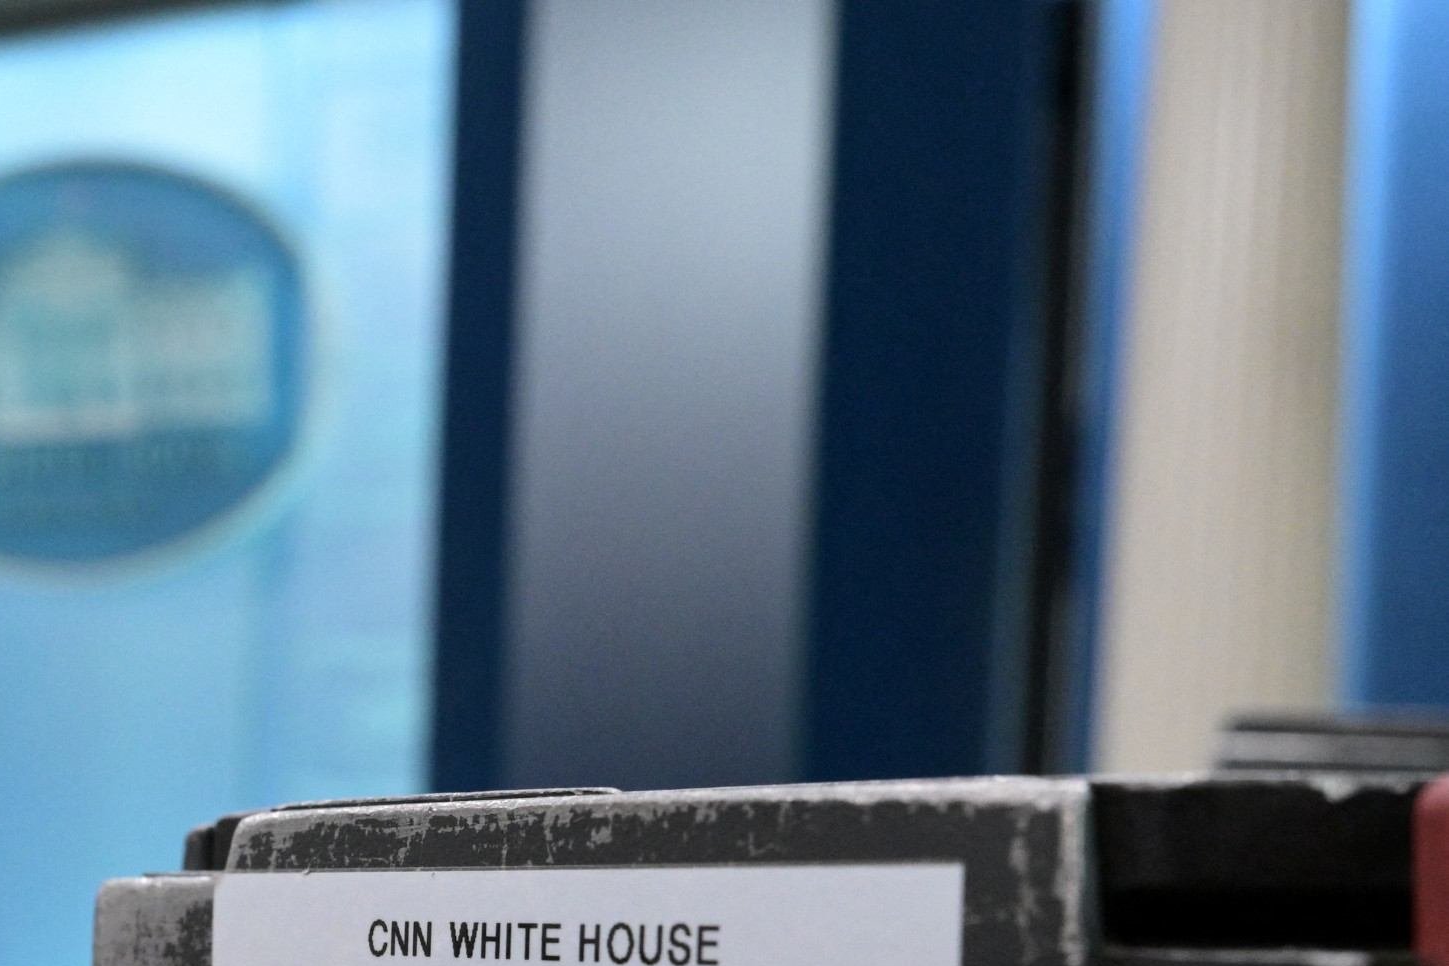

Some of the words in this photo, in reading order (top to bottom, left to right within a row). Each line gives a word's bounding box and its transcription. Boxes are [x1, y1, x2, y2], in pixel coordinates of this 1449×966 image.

[368, 918, 432, 959] CNN
[449, 921, 561, 962] WHITE
[577, 923, 721, 966] HOUSE
